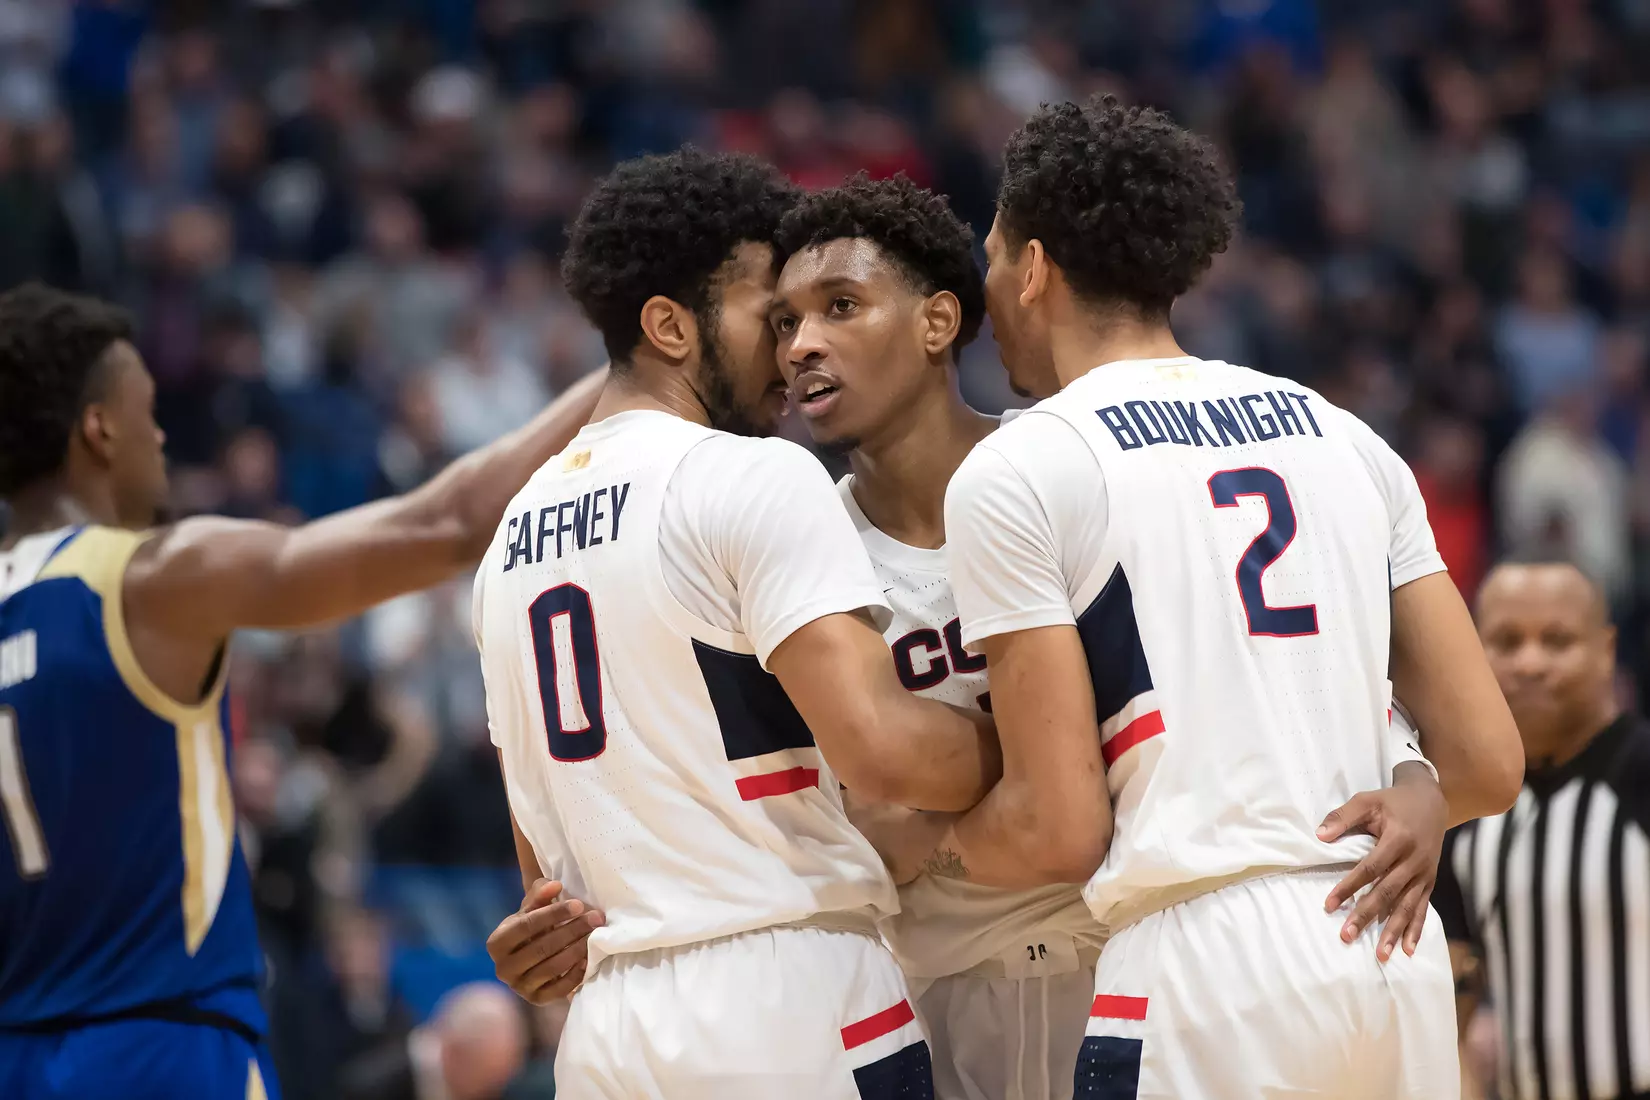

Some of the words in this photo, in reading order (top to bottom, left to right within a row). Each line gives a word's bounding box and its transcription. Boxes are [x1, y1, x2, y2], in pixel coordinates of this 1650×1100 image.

[1095, 390, 1324, 451] BOUKNIGHT
[502, 482, 631, 573] GAFFNEY
[1207, 466, 1319, 637] 2
[528, 581, 607, 762] 0
